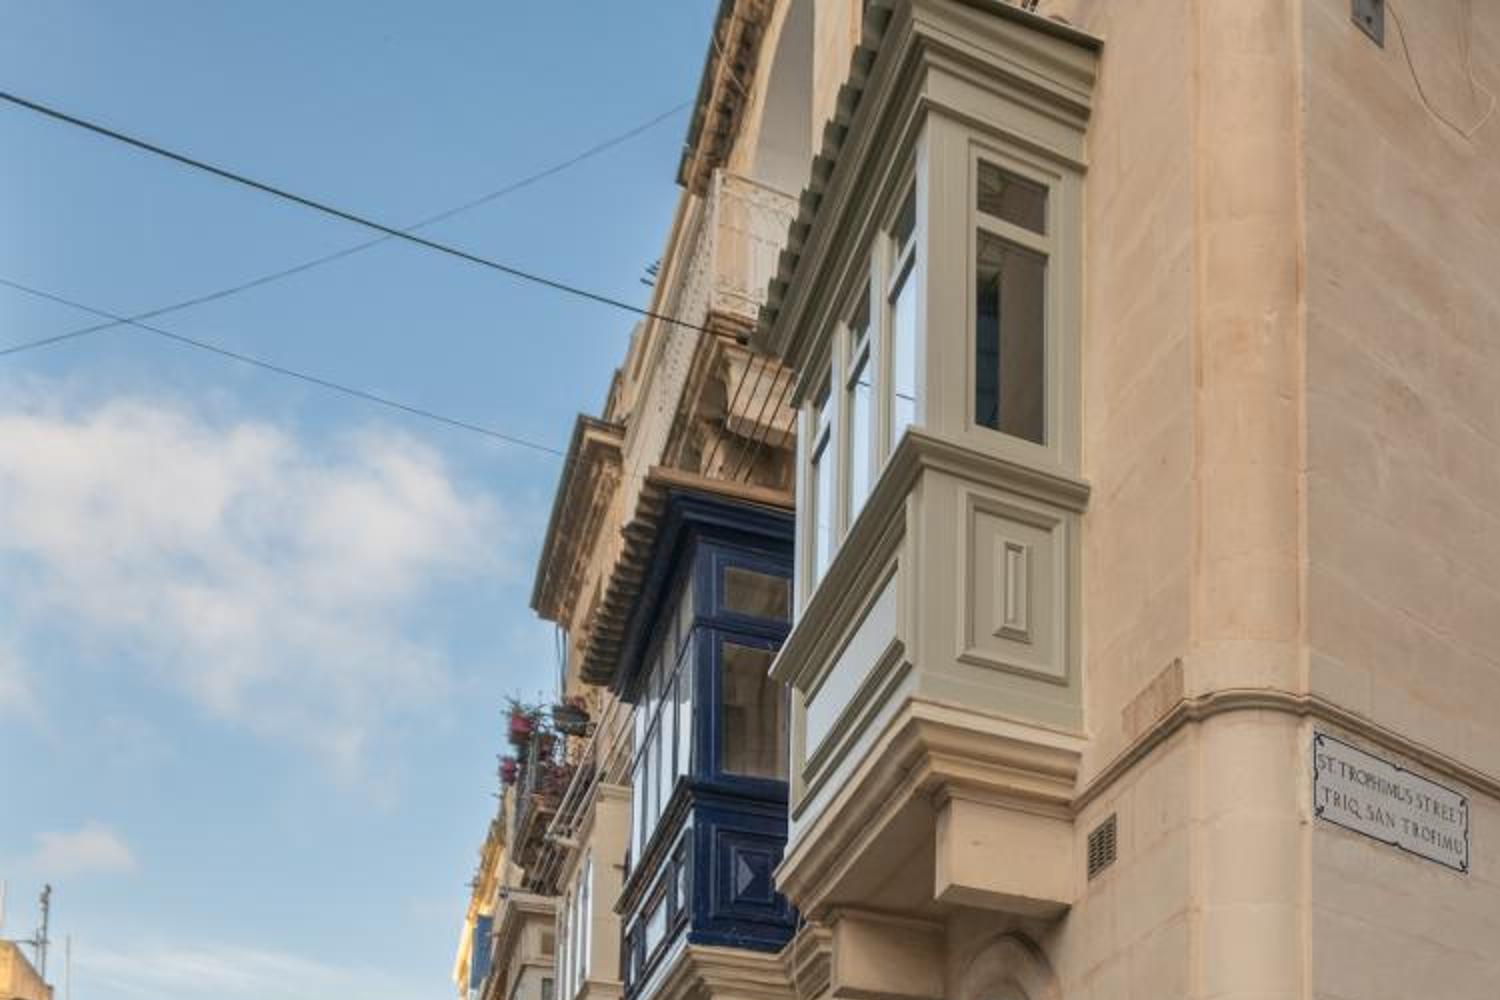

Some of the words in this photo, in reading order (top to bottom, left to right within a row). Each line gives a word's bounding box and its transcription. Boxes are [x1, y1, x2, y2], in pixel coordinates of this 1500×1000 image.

[1321, 785, 1362, 820] TRIQ
[1366, 803, 1396, 828] SAN
[1401, 817, 1463, 855] TROFIMU
[1415, 792, 1464, 828] STREET
